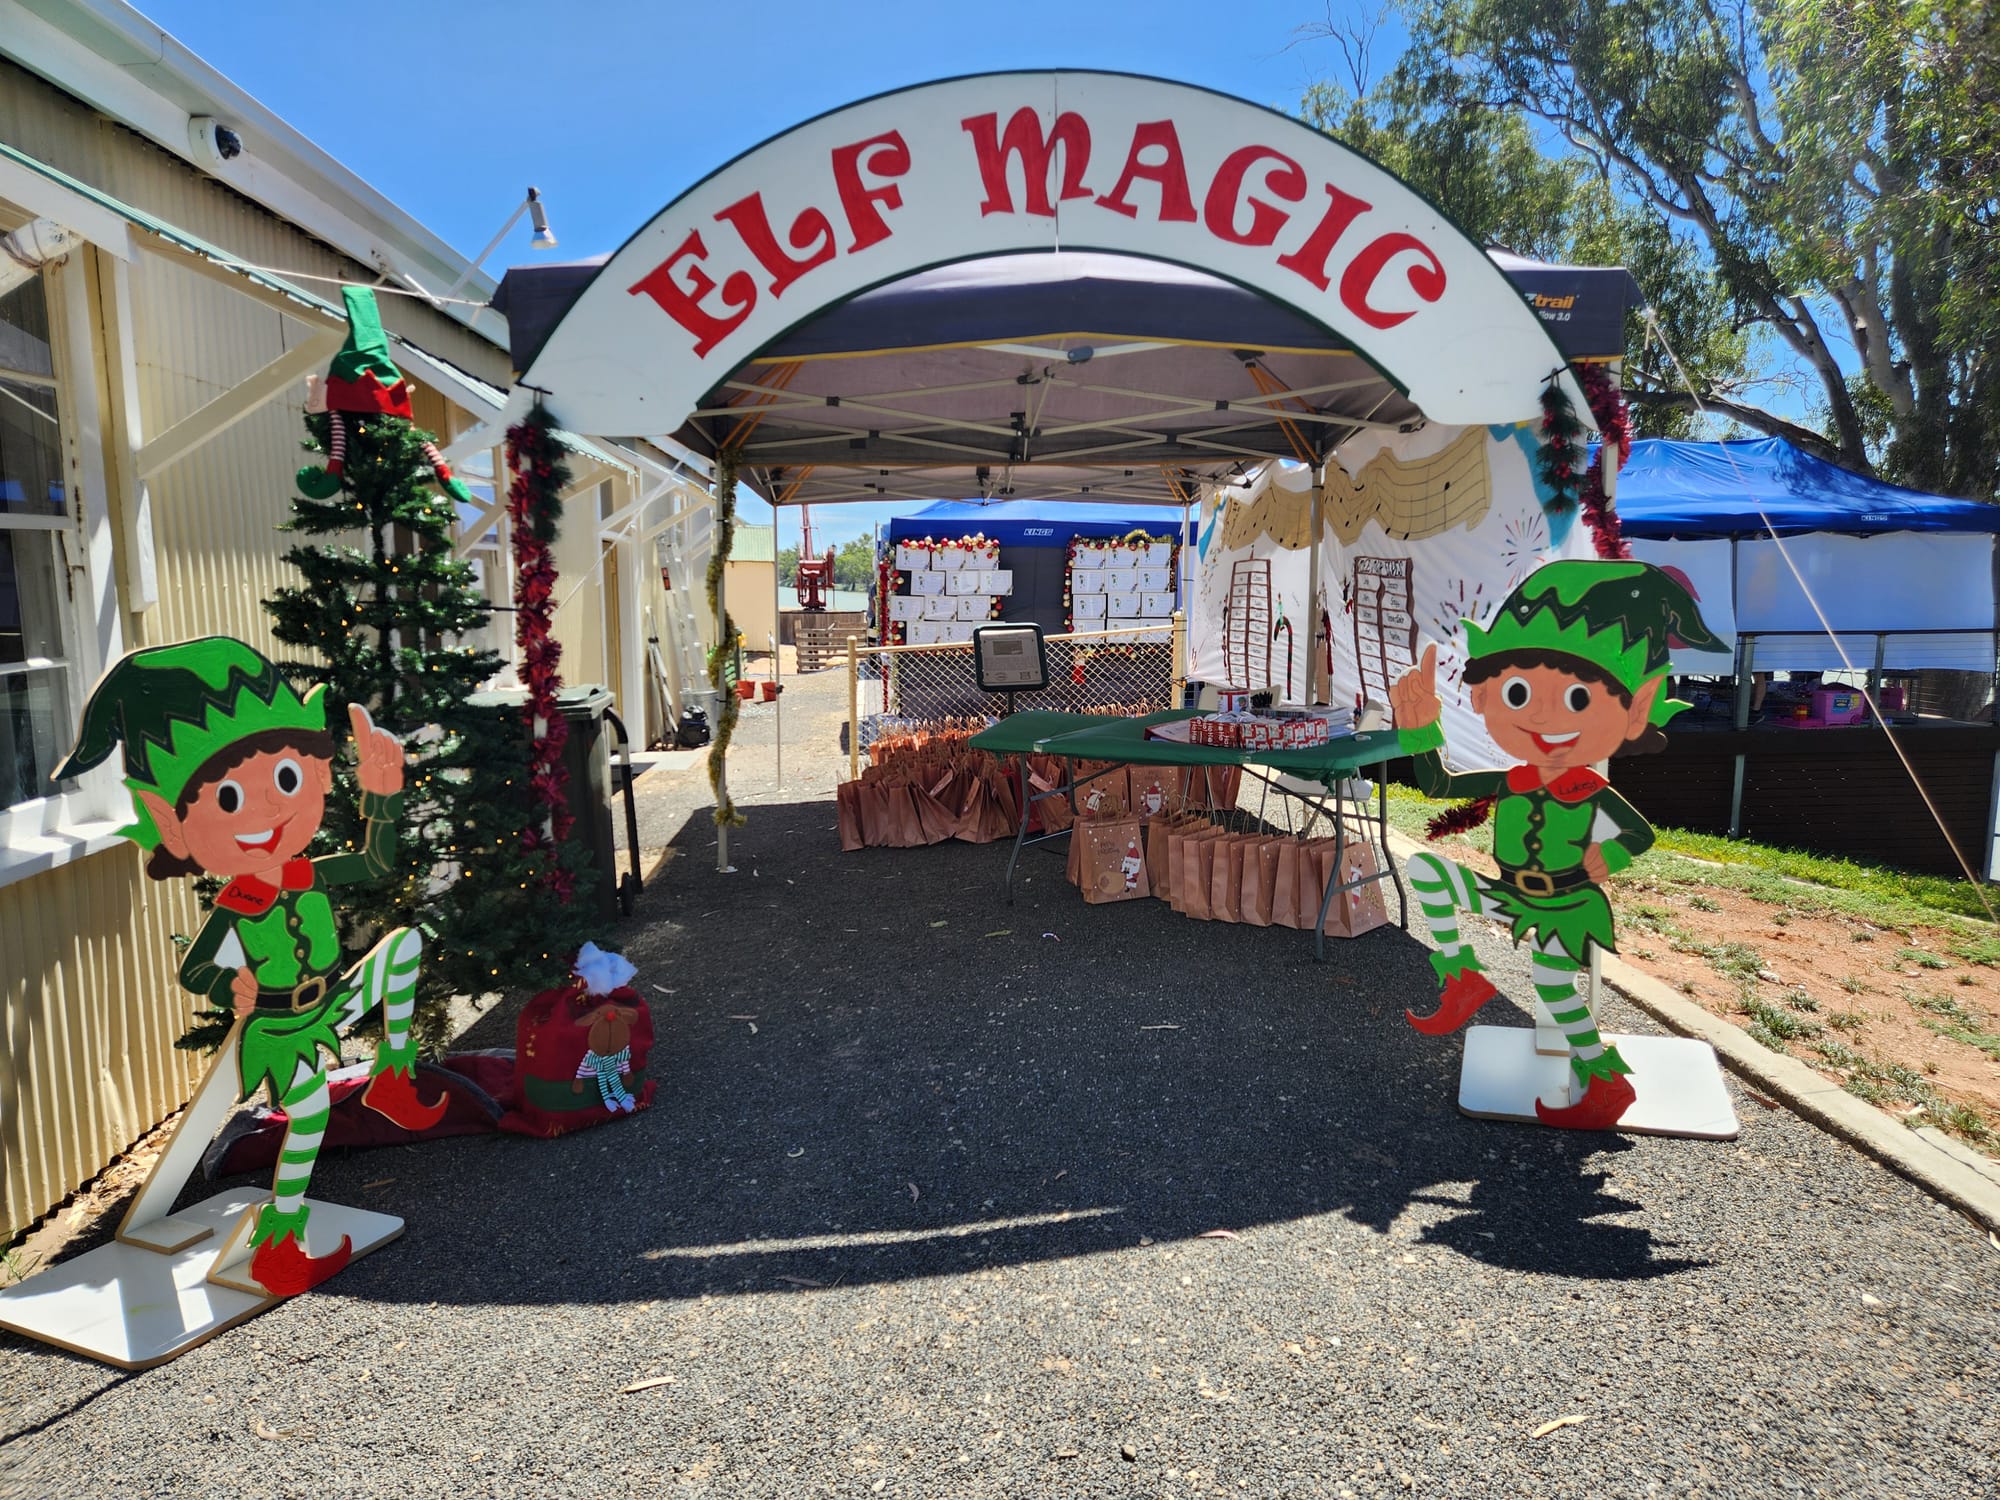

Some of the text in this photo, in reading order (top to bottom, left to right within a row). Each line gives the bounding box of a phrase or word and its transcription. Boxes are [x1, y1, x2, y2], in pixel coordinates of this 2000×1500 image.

[627, 106, 1447, 360] ELF MAGIC
[1023, 528, 1054, 536] KINGS
[228, 885, 264, 906] Duane
